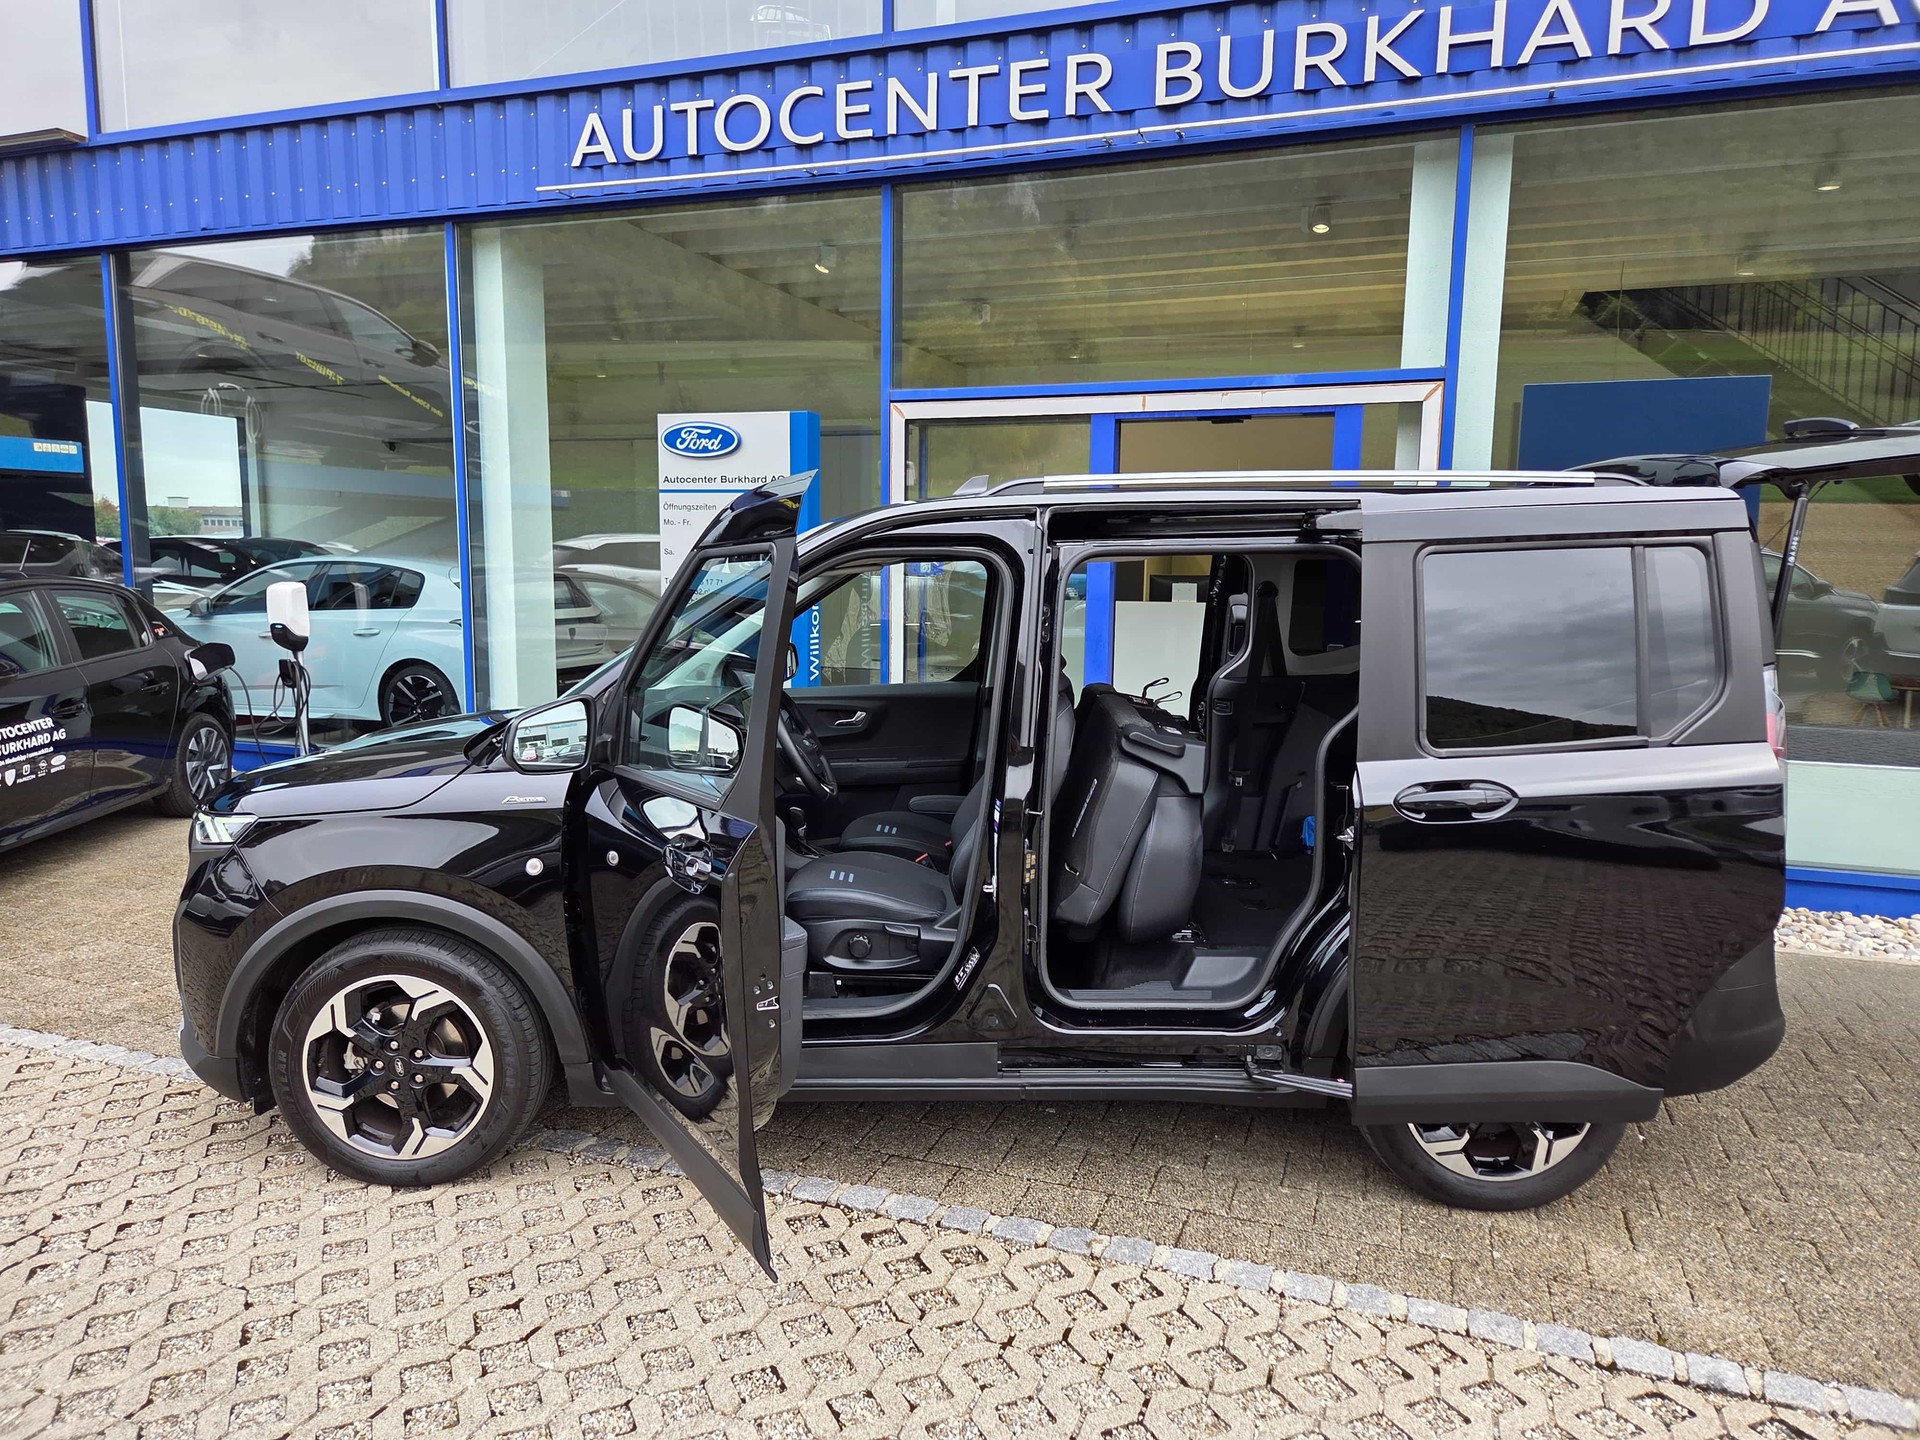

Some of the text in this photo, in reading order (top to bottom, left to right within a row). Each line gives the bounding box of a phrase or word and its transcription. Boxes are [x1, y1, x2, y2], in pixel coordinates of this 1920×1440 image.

[571, 52, 1113, 167] AUTOCENTER
[1155, 0, 1769, 106] BURKHARD
[676, 427, 723, 450] Ford
[663, 475, 717, 484] Autocenter
[720, 475, 767, 484] Burkhard
[663, 501, 717, 512] Öffnungszeiten
[664, 547, 675, 556] Sa.
[0, 716, 55, 741] TOCENTER
[0, 733, 51, 756] URKHARD
[52, 728, 67, 742] AG
